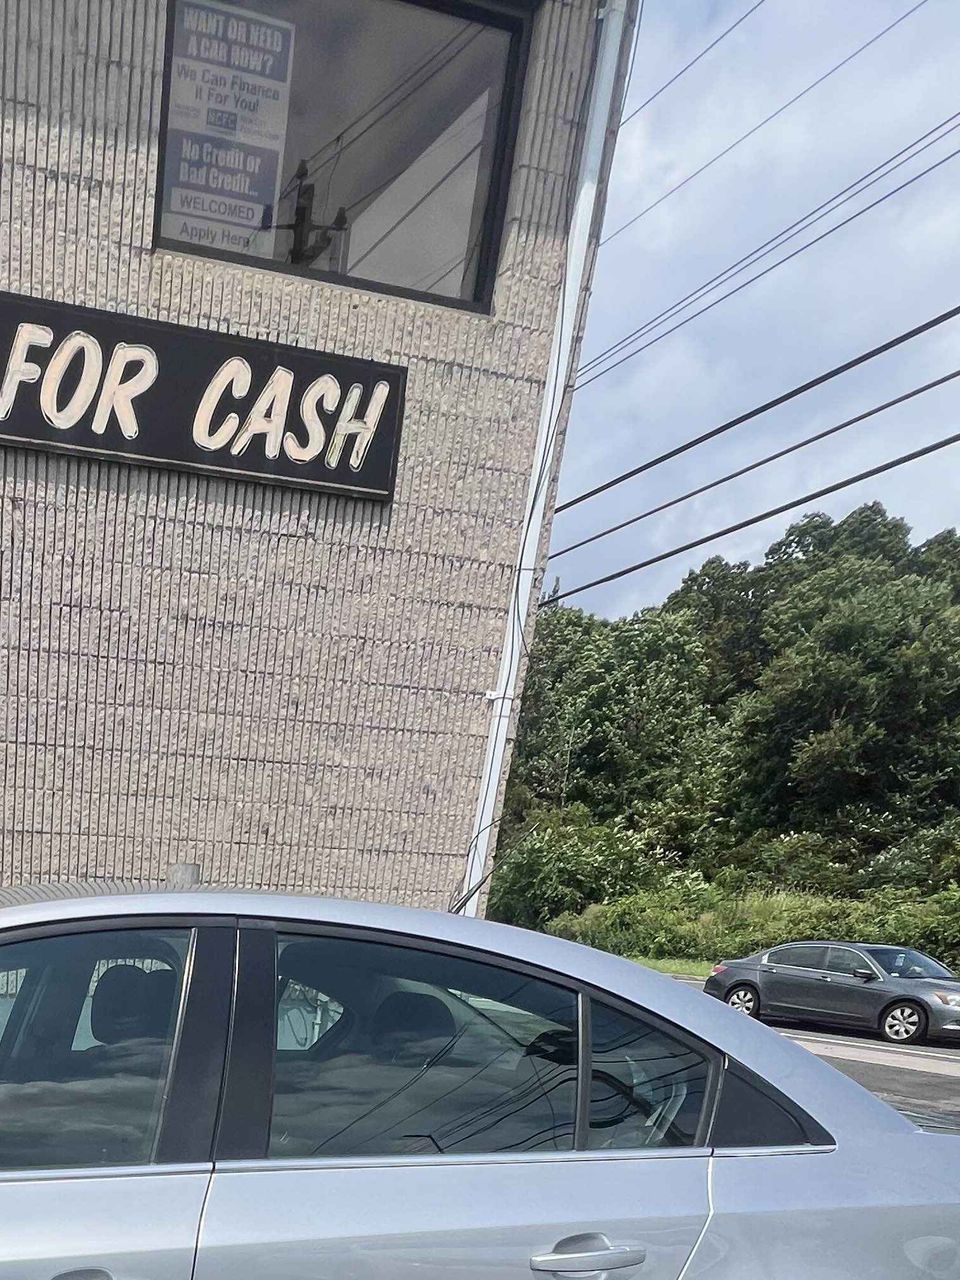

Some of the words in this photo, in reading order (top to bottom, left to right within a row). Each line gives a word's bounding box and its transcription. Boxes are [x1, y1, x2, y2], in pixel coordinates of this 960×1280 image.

[183, 7, 226, 38] WANT
[227, 18, 247, 43] OR
[249, 23, 282, 53] NEED
[188, 34, 199, 57] A
[200, 37, 228, 63] CAR
[230, 44, 274, 75] NOW?
[177, 64, 197, 81] We
[201, 69, 227, 89] Can
[230, 75, 280, 101] Finance
[207, 86, 230, 105] For
[233, 92, 260, 113] You!
[180, 161, 207, 185] Bad
[182, 138, 200, 161] No
[202, 143, 244, 170] Credit
[246, 155, 261, 174] or
[180, 193, 255, 220] WELCOMED
[180, 220, 217, 244] Apply
[220, 227, 251, 249] Here
[191, 355, 391, 473] CASH
